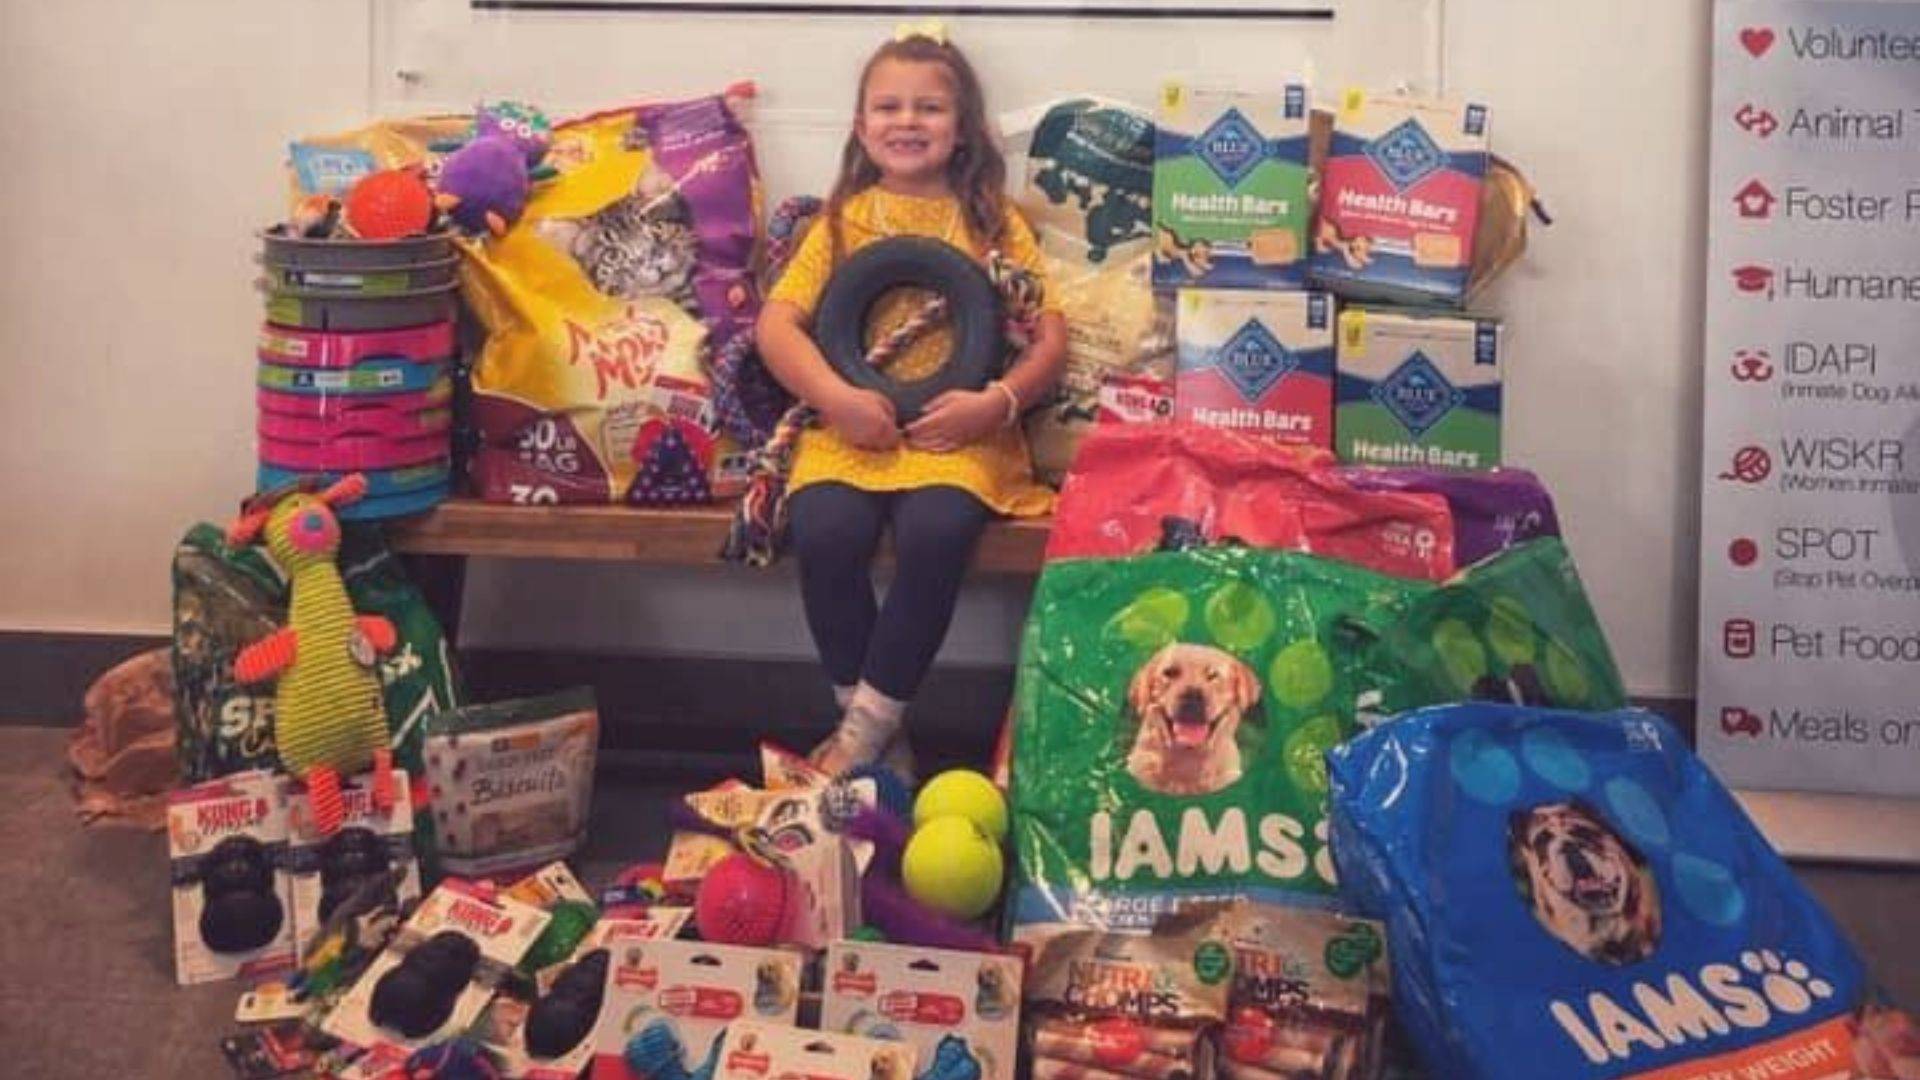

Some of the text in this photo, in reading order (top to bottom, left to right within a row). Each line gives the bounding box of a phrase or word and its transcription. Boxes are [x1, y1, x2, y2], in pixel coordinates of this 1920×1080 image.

[1788, 105, 1903, 139] Animal
[1172, 191, 1289, 216] Health Bars
[1337, 187, 1458, 222] Health Bars
[1786, 186, 1892, 220] Foster
[1784, 266, 1920, 300] Humane
[1784, 341, 1876, 376] IDAPI
[1191, 406, 1314, 432] Health Bars
[1352, 438, 1480, 468] Health Bars
[1780, 437, 1903, 473] WISKR
[1774, 527, 1879, 561] SPOT
[1771, 622, 1920, 662] Pet Food
[1769, 708, 1870, 744] Meals
[1090, 807, 1308, 880] IAMS
[1550, 963, 1771, 1064] IAMS
[1739, 1038, 1836, 1080] WEIGHT
